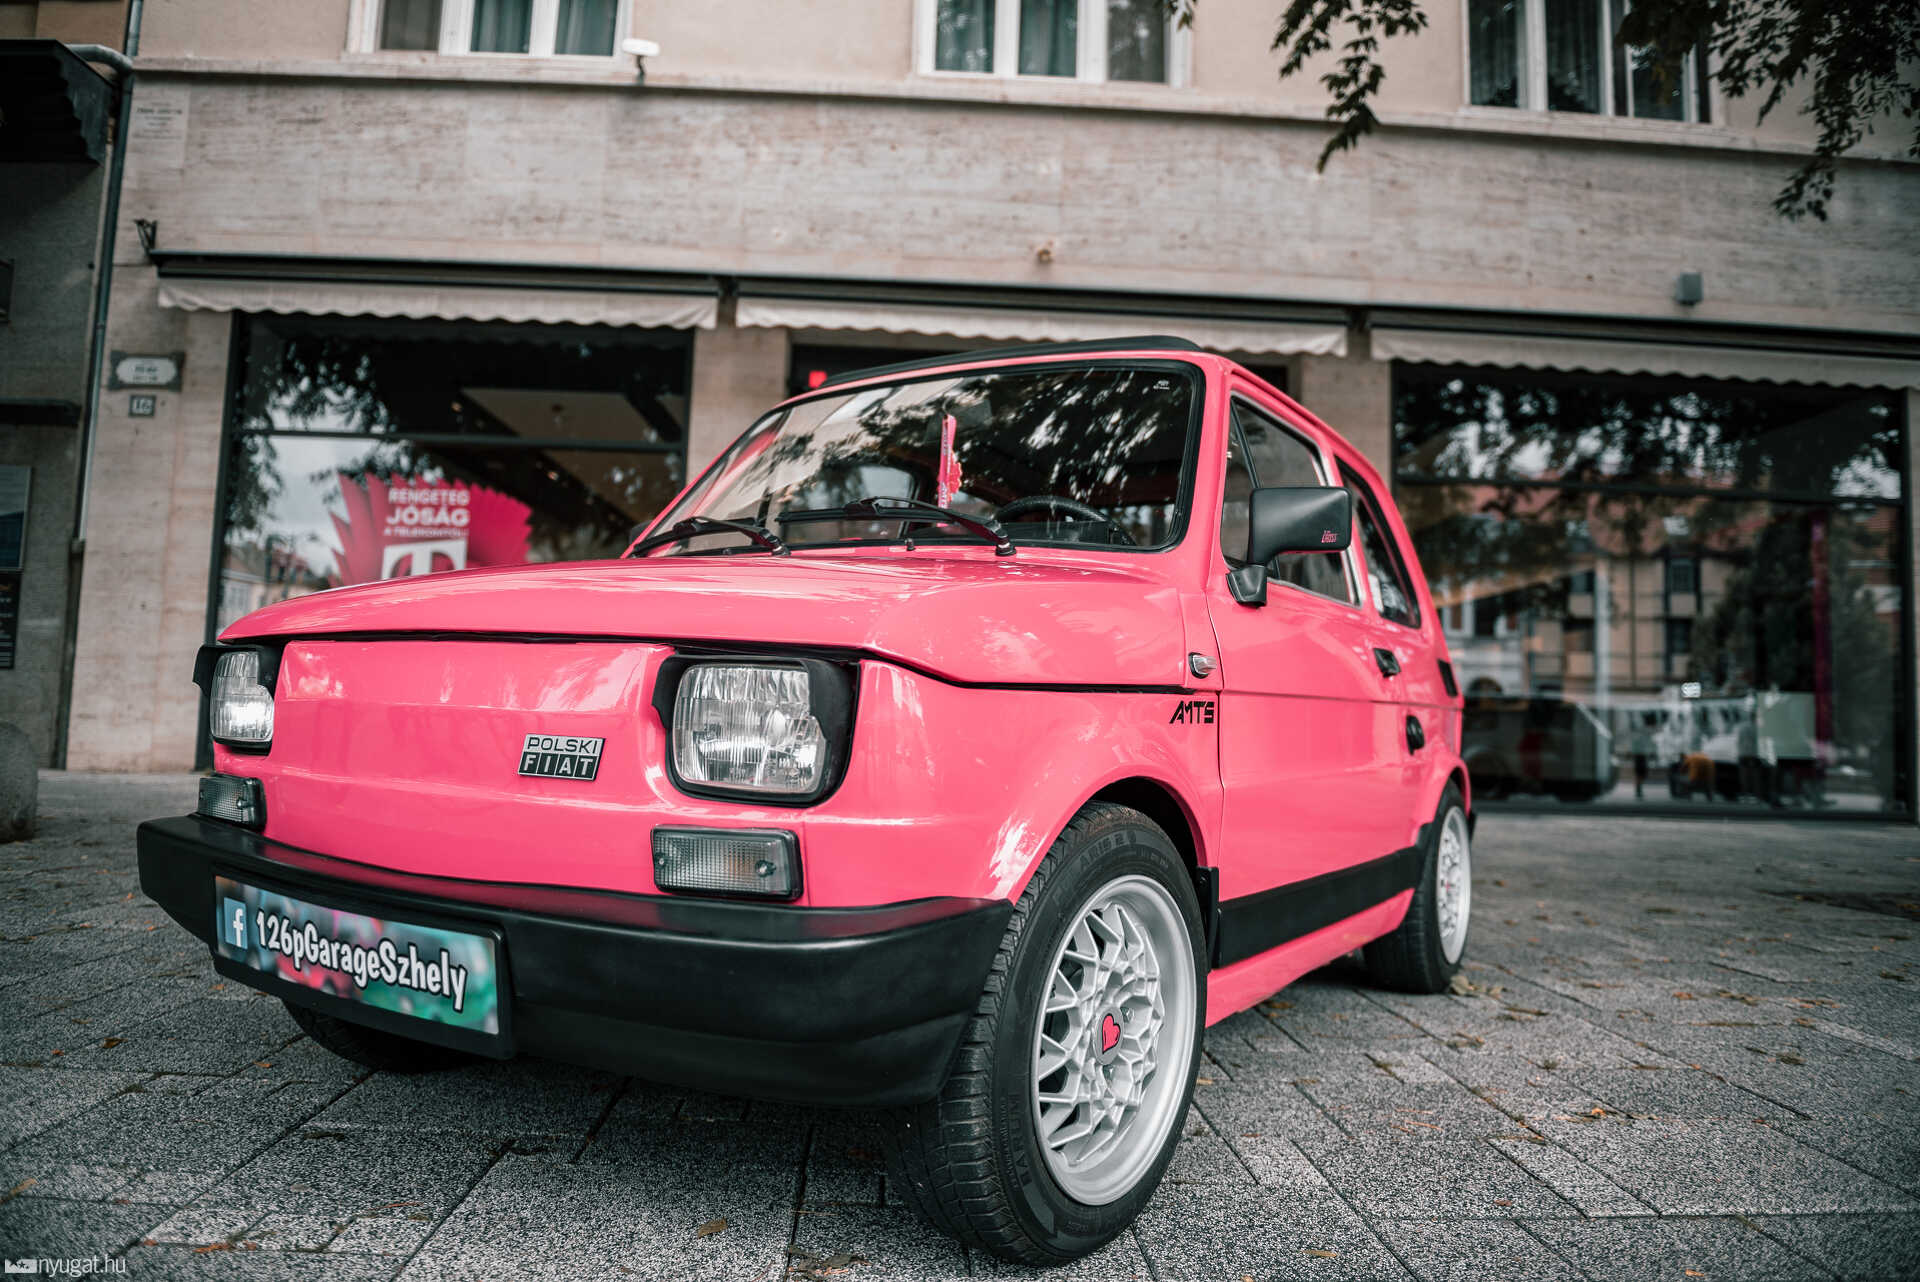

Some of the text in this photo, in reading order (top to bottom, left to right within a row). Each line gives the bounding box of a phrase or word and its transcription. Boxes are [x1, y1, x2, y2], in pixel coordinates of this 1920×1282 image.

[388, 488, 471, 505] RENGETEG
[386, 504, 471, 527] JÓSÁG
[1169, 700, 1214, 724] AMTS
[527, 737, 598, 754] POLSKI
[523, 754, 594, 776] FIAT
[256, 909, 467, 1012] 126pGarageSzhely
